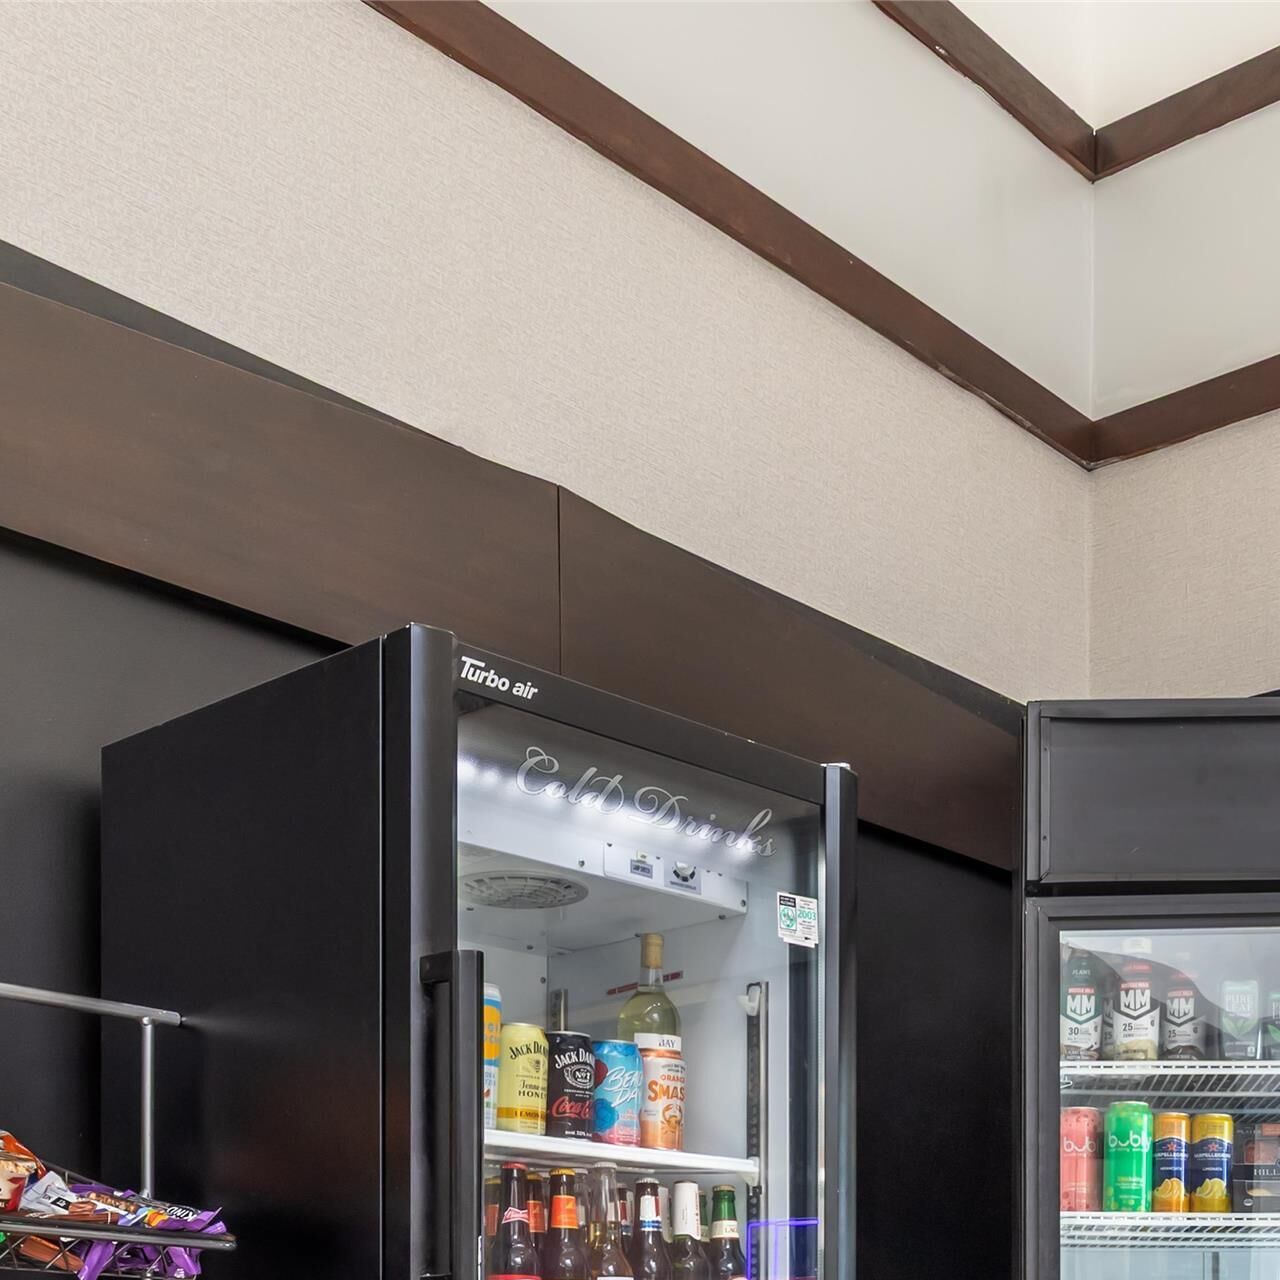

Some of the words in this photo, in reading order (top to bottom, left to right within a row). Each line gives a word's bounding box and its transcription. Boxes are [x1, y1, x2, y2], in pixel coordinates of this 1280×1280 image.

[460, 655, 510, 692] Turbo
[512, 681, 538, 701] air
[516, 746, 624, 815] Cold
[624, 785, 777, 857] Drinks
[1068, 1026, 1079, 1035] 30
[1122, 1023, 1133, 1031] 25
[509, 1043, 532, 1060] JACK
[554, 1050, 578, 1069] JACK
[648, 1079, 685, 1102] SMAS
[1108, 1130, 1152, 1153] bubly
[167, 1206, 197, 1222] KIND
